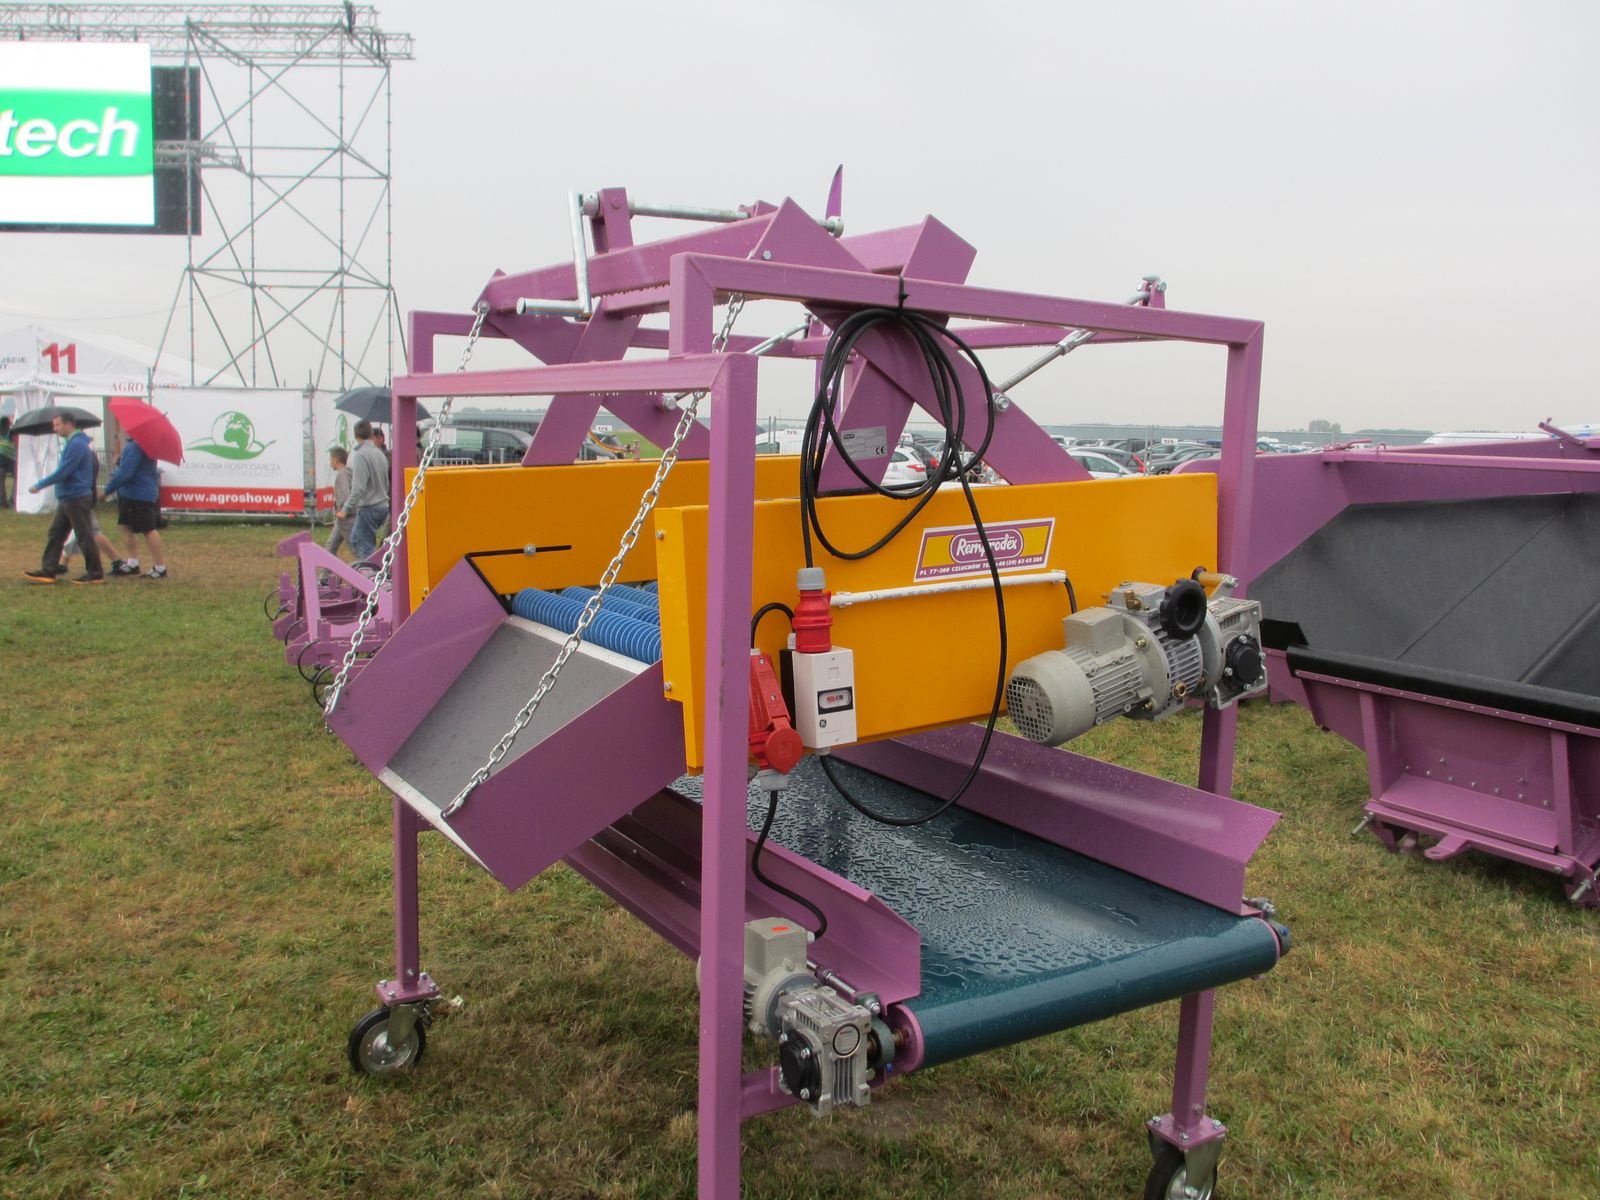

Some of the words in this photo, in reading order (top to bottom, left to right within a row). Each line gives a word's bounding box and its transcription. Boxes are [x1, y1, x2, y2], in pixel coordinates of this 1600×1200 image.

[0, 107, 139, 158] tech
[42, 342, 77, 374] 11
[111, 382, 144, 393] AGRO
[171, 492, 290, 506] www.agroshow.pl
